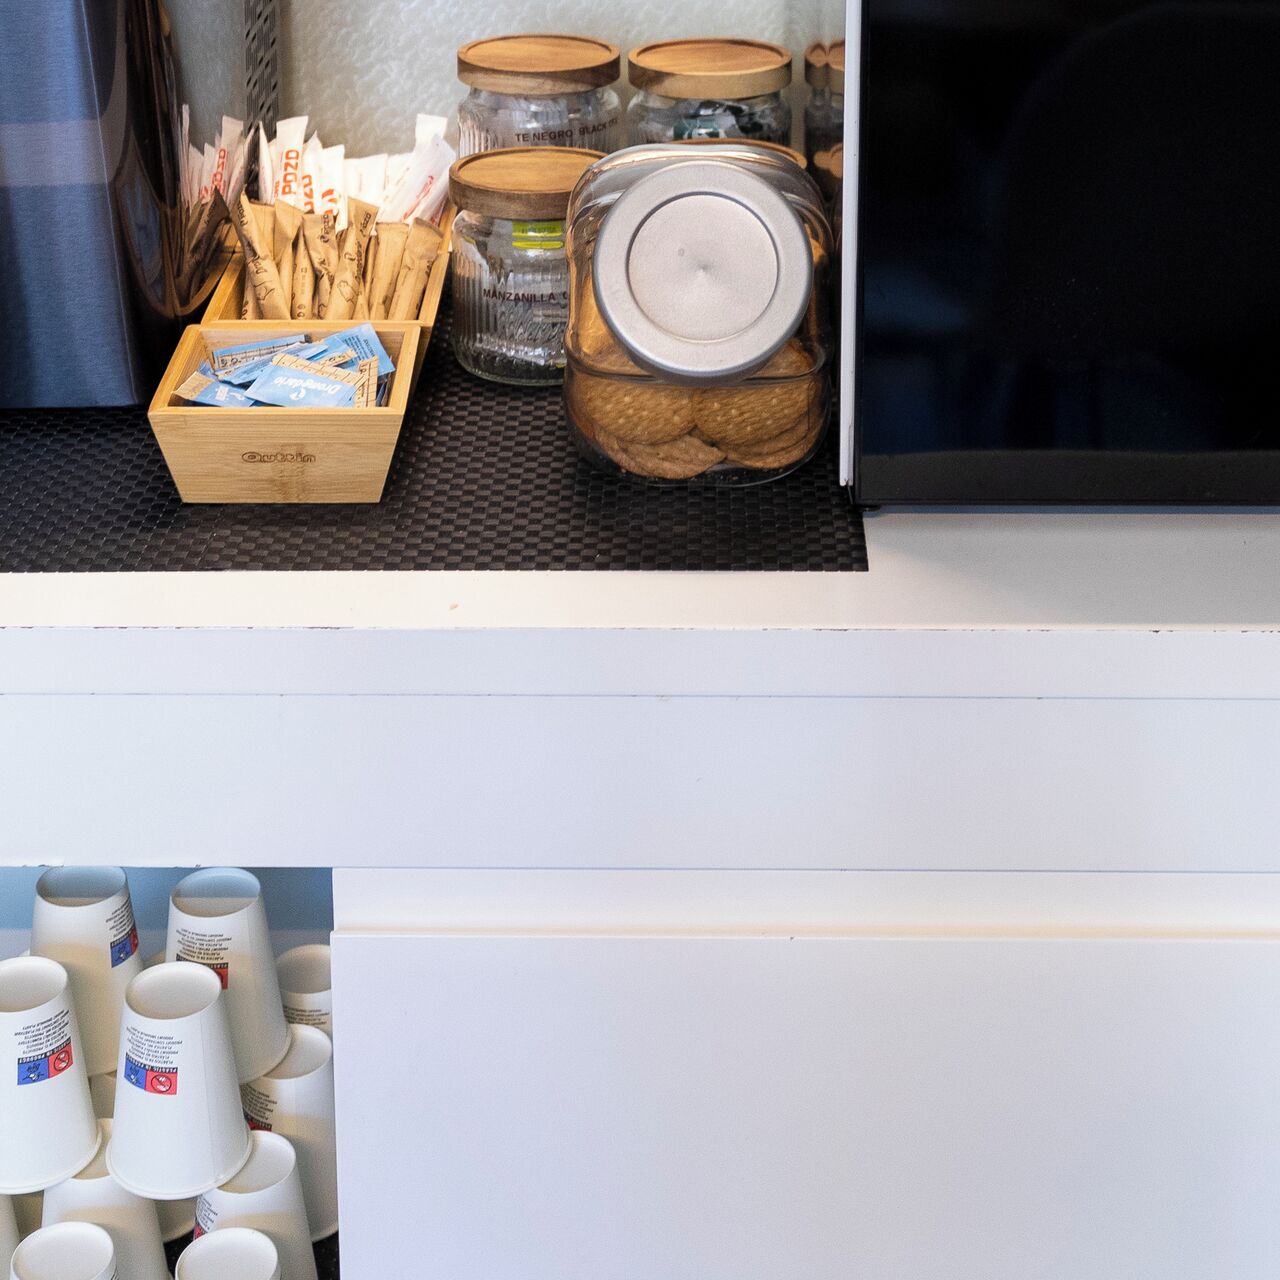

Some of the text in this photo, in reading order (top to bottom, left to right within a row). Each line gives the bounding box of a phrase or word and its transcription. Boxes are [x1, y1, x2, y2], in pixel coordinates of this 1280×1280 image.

[532, 130, 574, 141] NEGRO
[578, 122, 608, 136] BLACK
[483, 288, 556, 303] MANZANILLA
